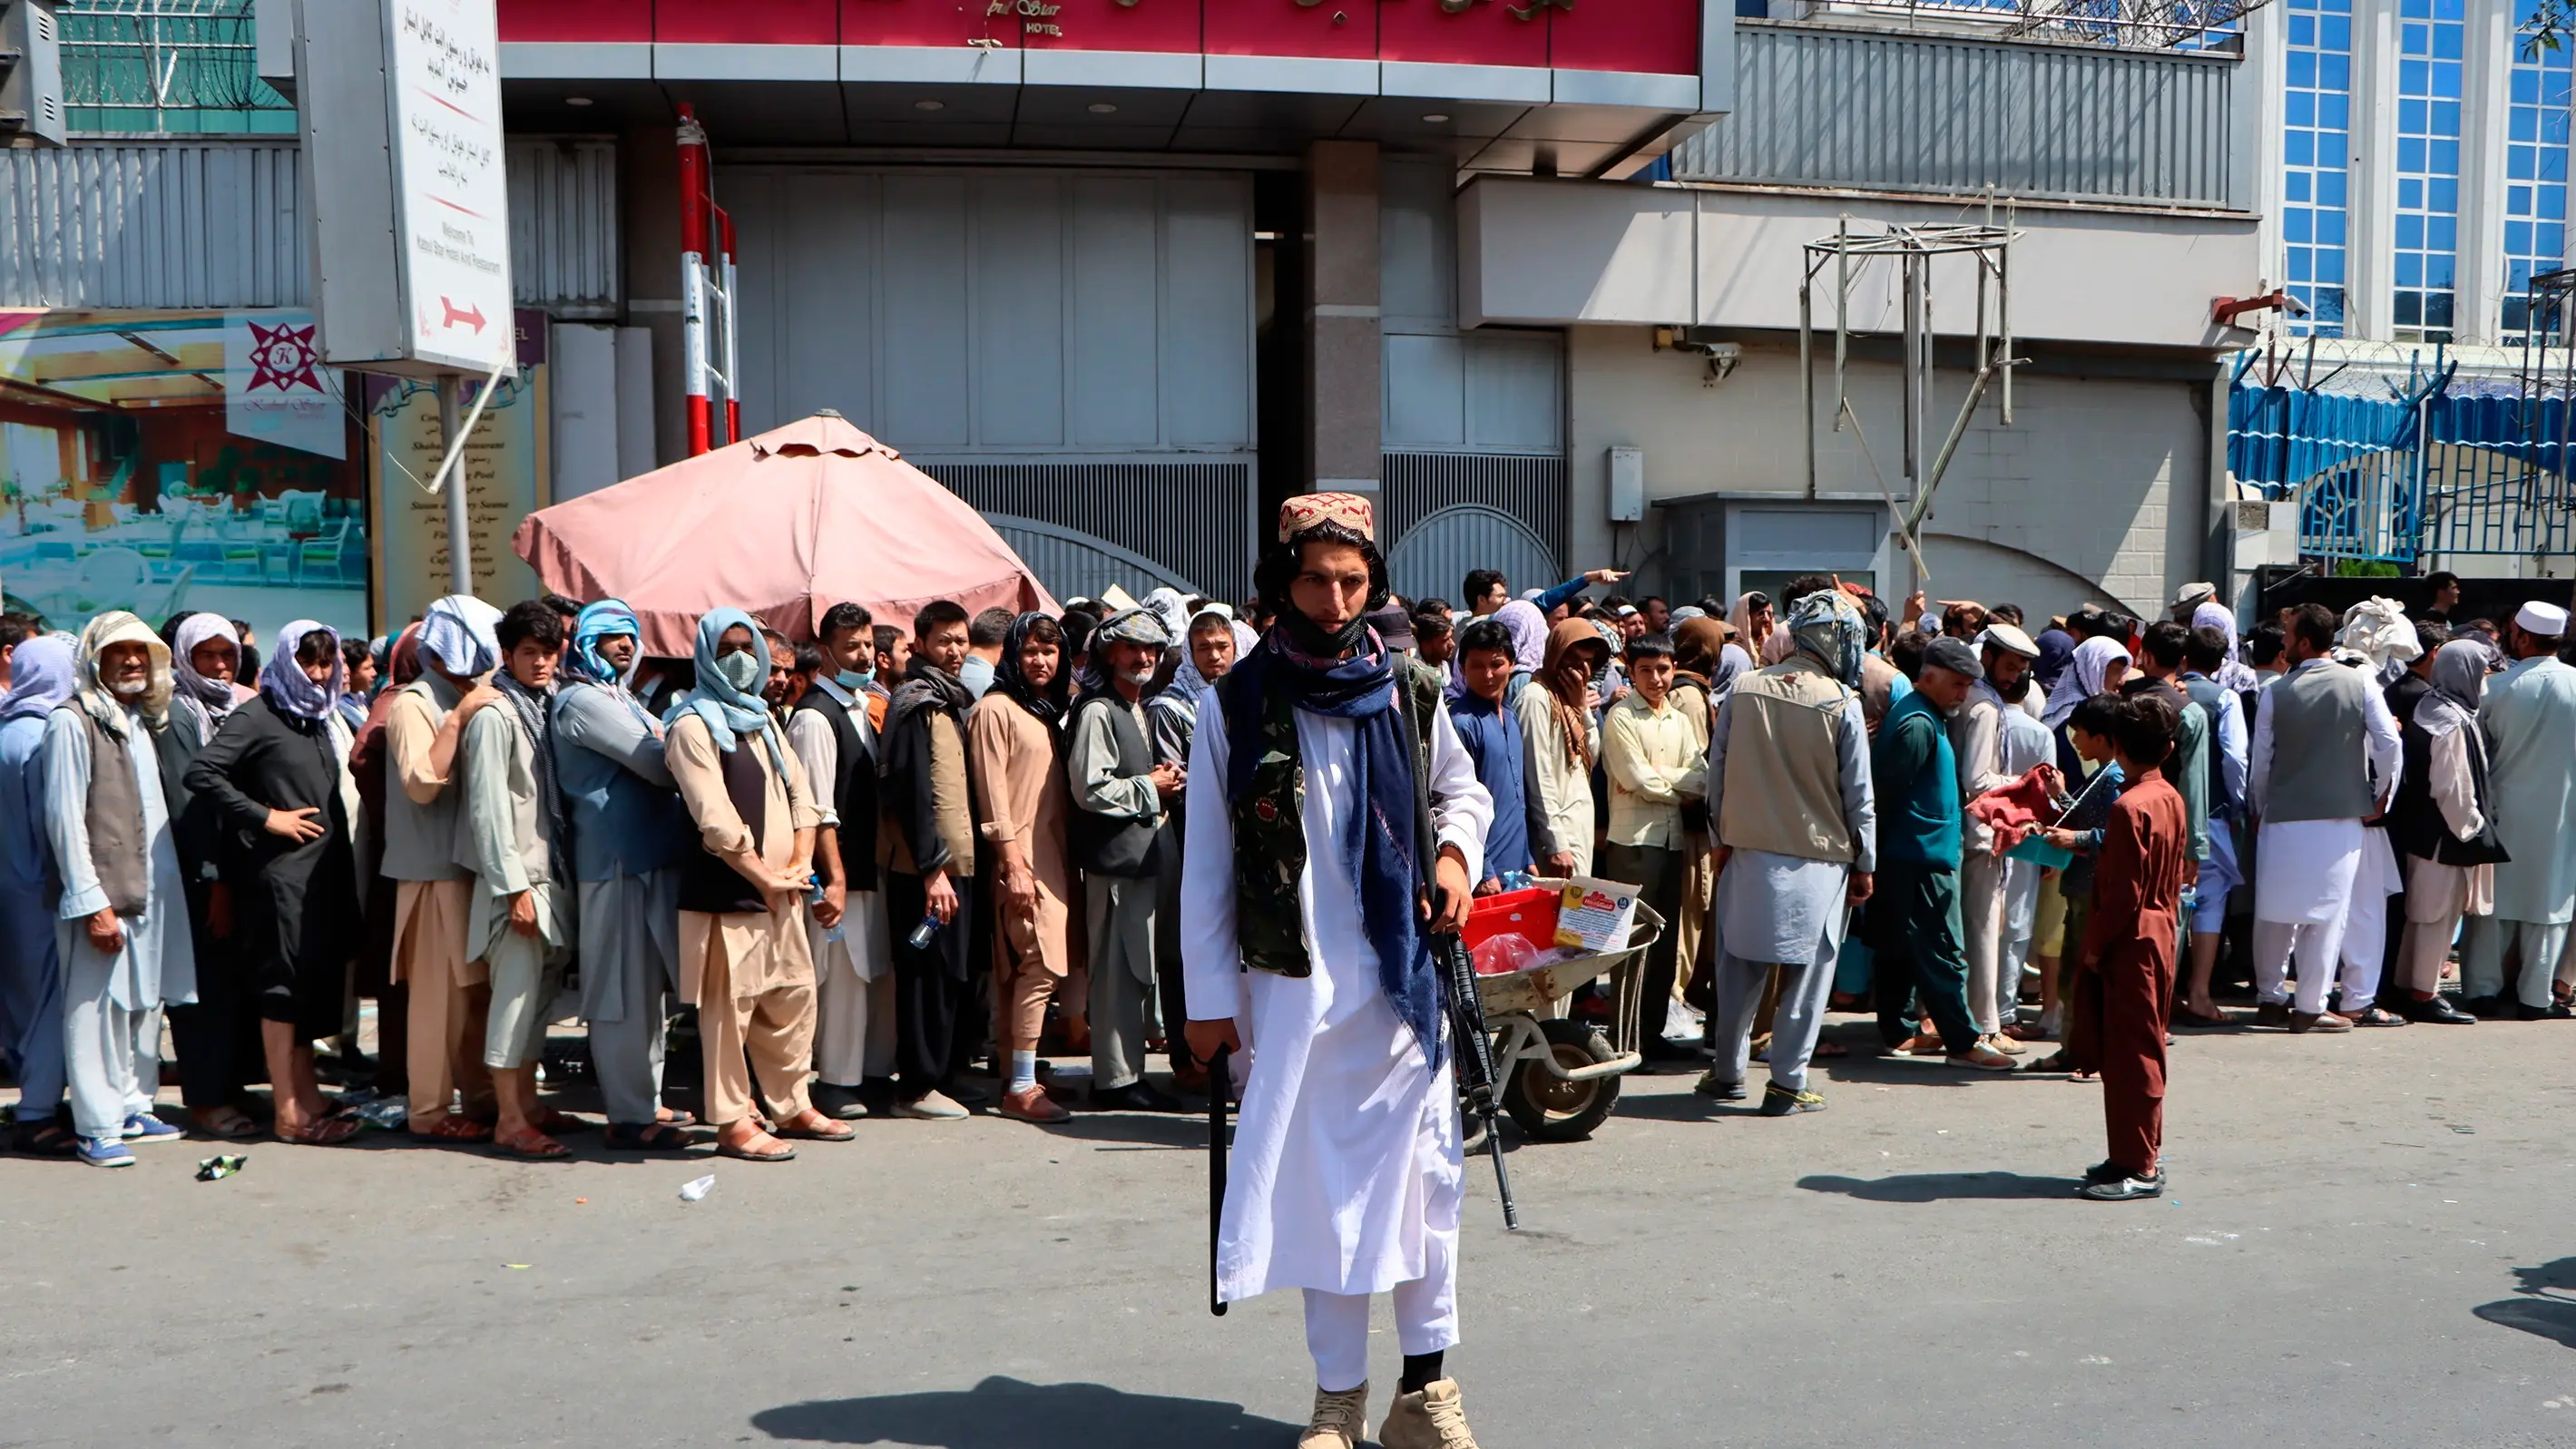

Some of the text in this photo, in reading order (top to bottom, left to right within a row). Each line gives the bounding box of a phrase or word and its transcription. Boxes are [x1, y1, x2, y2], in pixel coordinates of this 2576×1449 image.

[1026, 23, 1063, 37] HOTEL
[442, 221, 466, 245] Welcome
[274, 347, 293, 365] K
